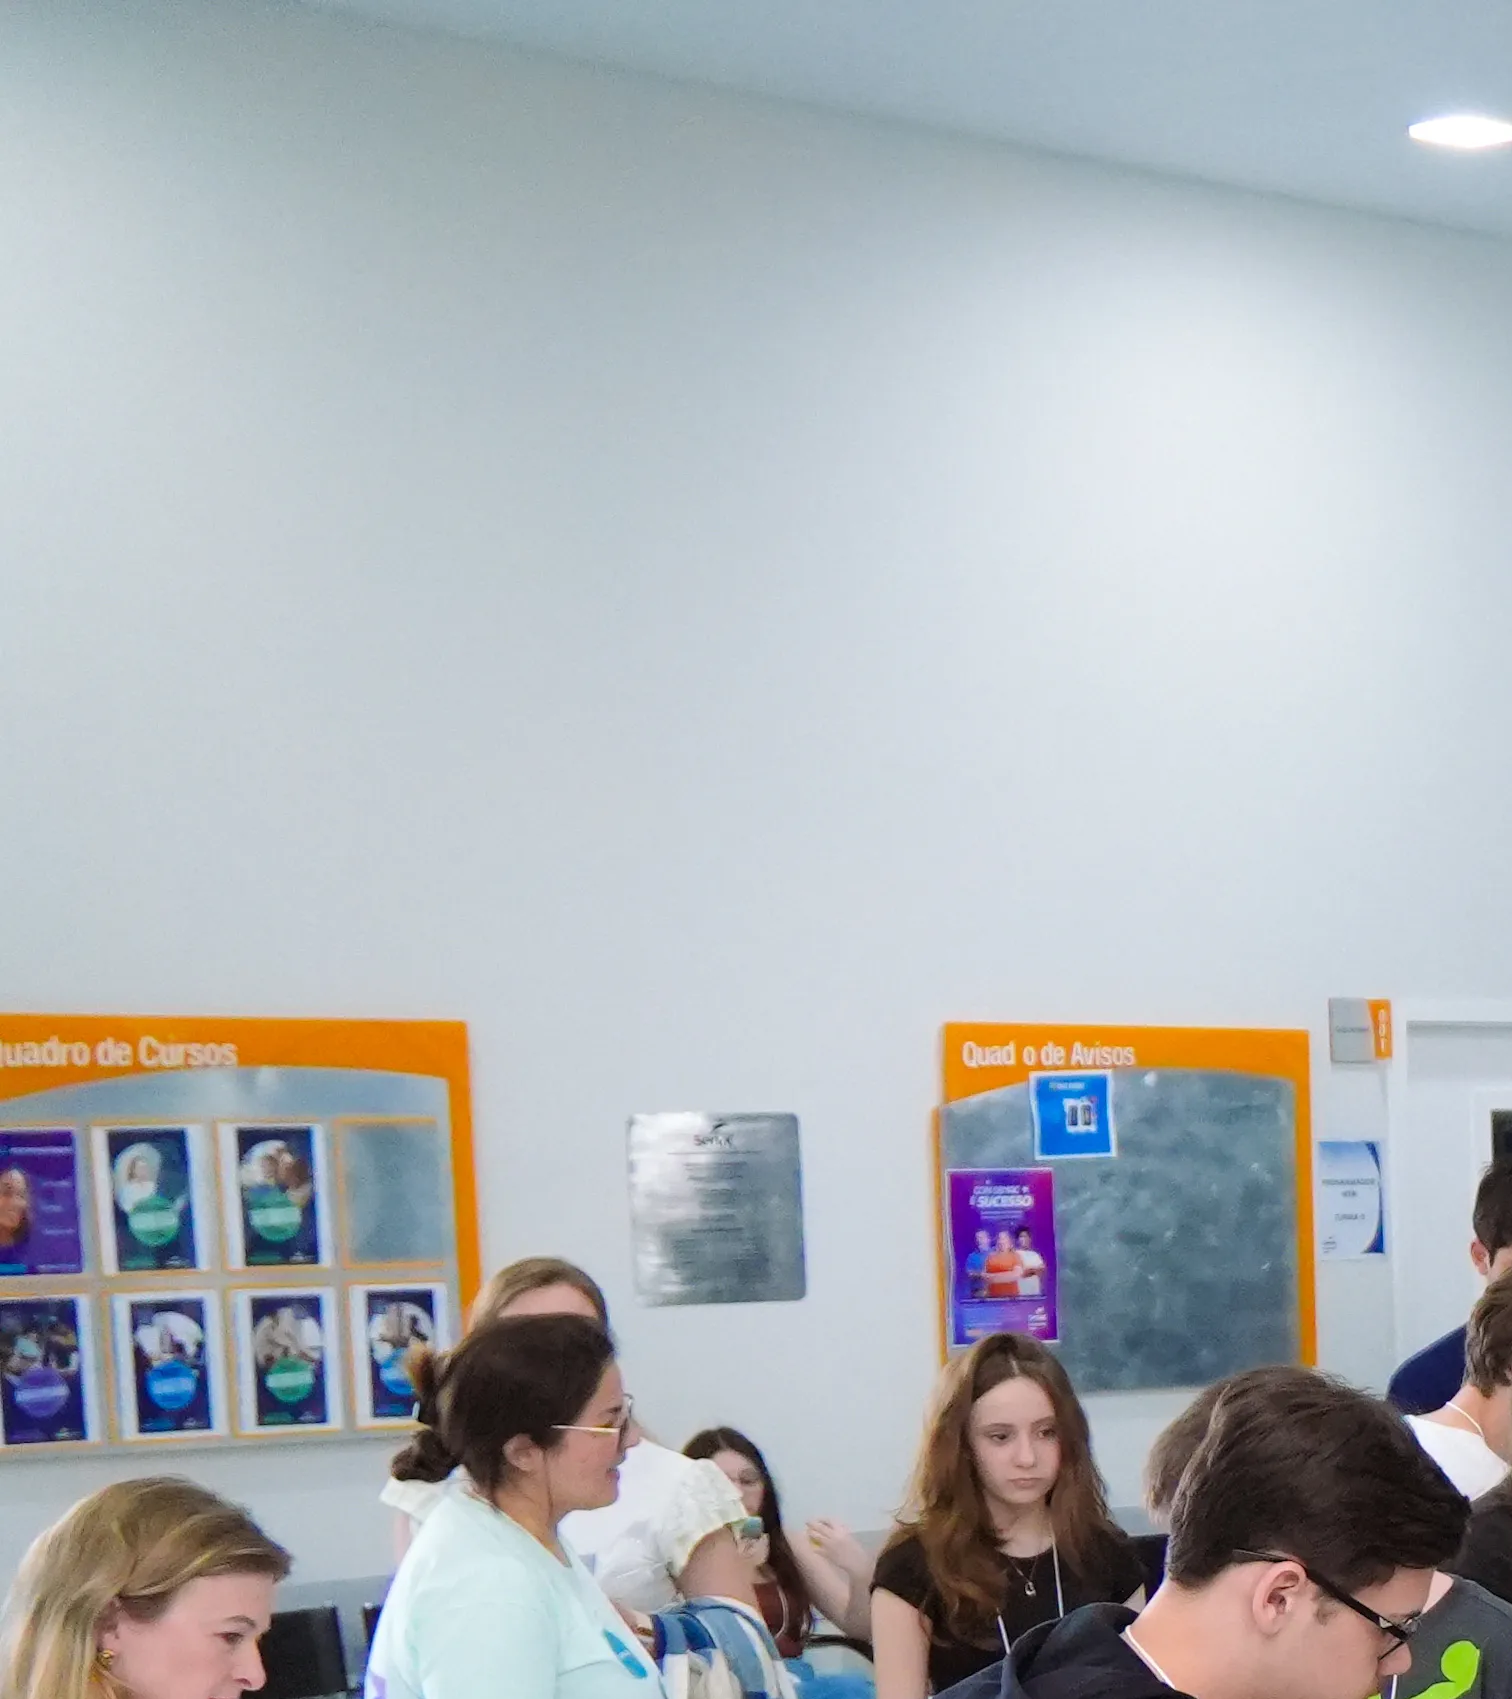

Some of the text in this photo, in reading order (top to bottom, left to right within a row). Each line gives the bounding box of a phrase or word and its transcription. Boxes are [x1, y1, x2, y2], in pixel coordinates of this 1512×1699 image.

[0, 1035, 238, 1068] uadro de Cursos
[1040, 1041, 1065, 1066] de
[1070, 1041, 1135, 1066] Avisos
